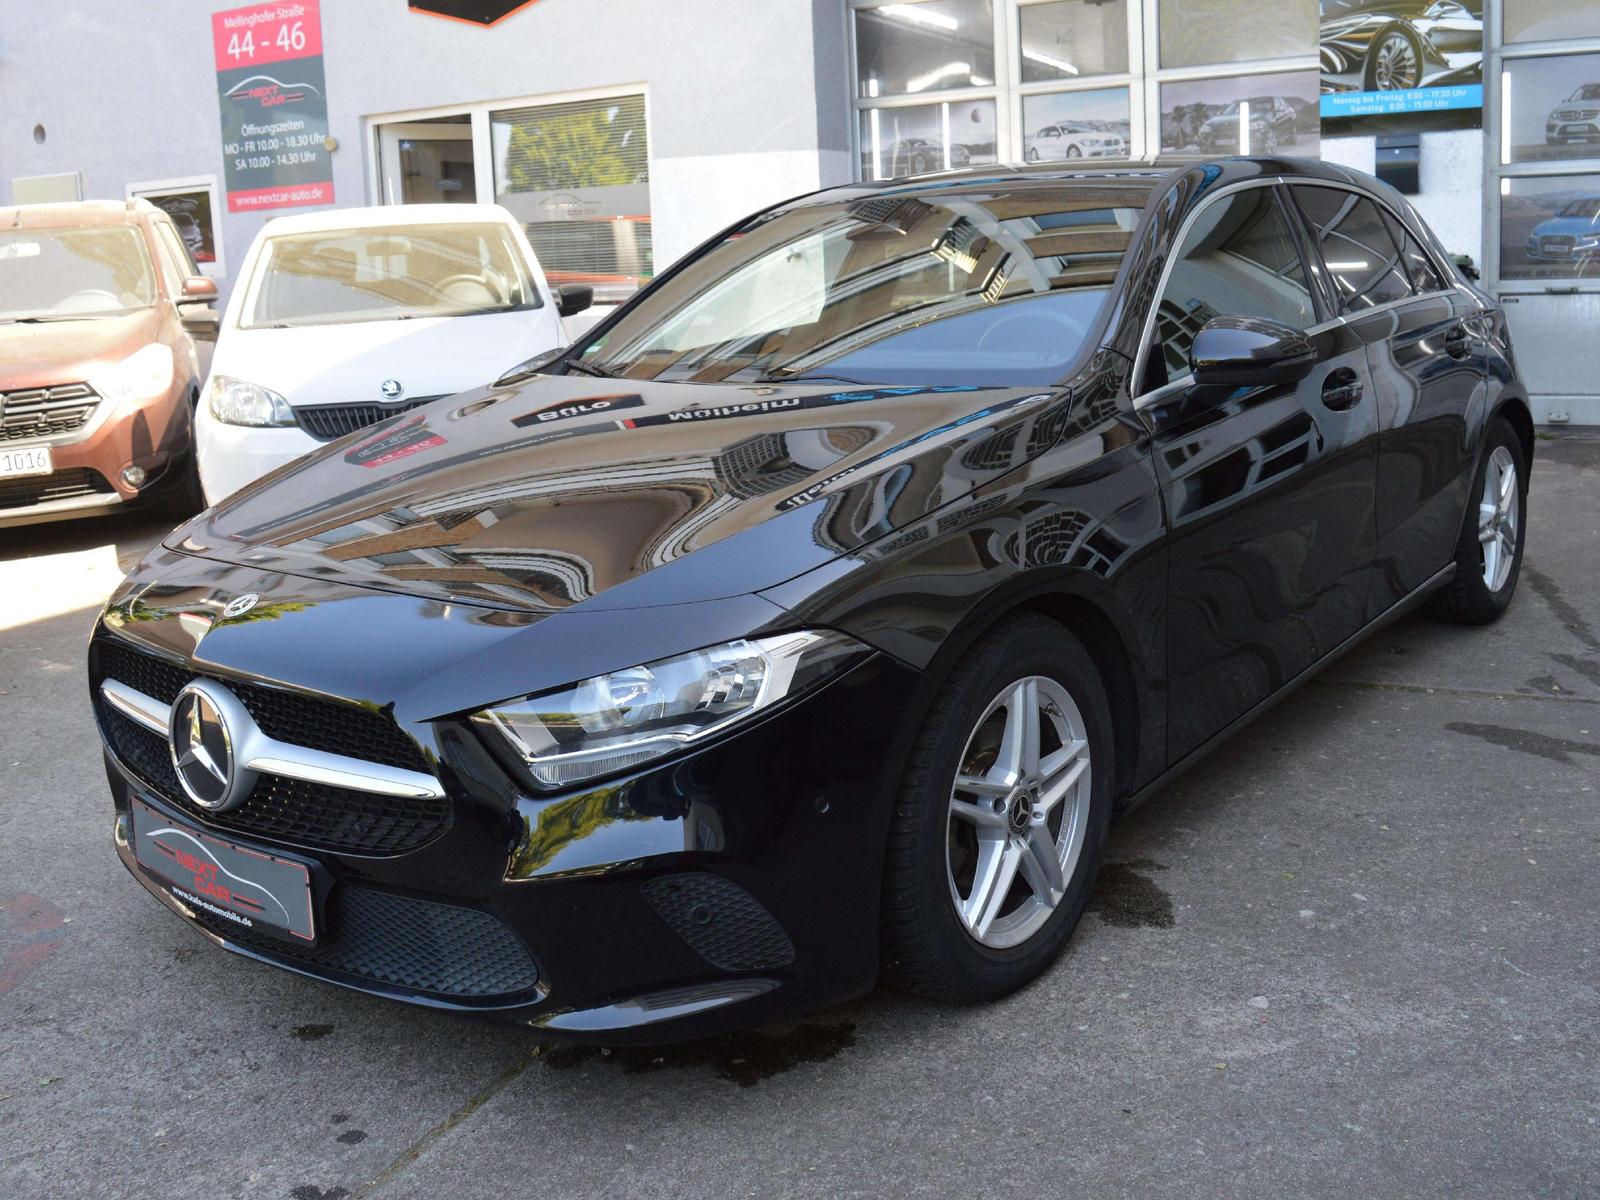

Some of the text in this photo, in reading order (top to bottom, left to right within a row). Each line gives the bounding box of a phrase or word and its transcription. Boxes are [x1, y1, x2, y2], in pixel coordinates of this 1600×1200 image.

[224, 5, 304, 29] Mellinghofer Straße
[227, 31, 255, 60] 44
[276, 21, 306, 52] 46
[248, 84, 279, 99] NEXT
[261, 94, 286, 107] CAR
[1333, 97, 1361, 105] Montag
[1452, 88, 1467, 96] Uhr
[1434, 100, 1449, 109] Uhr
[241, 120, 304, 137] Öffnungszeiten
[225, 143, 239, 155] MO
[245, 141, 256, 152] FR
[257, 138, 279, 151] 10.00
[309, 132, 326, 145] Uhr
[235, 158, 247, 170] SA
[249, 156, 270, 168] 10.00
[300, 150, 317, 163] Uhr
[236, 187, 323, 206] www.nextcar-auto.de
[3, 451, 46, 472] 1016
[174, 849, 219, 881] NEXT
[194, 874, 231, 903] CAR
